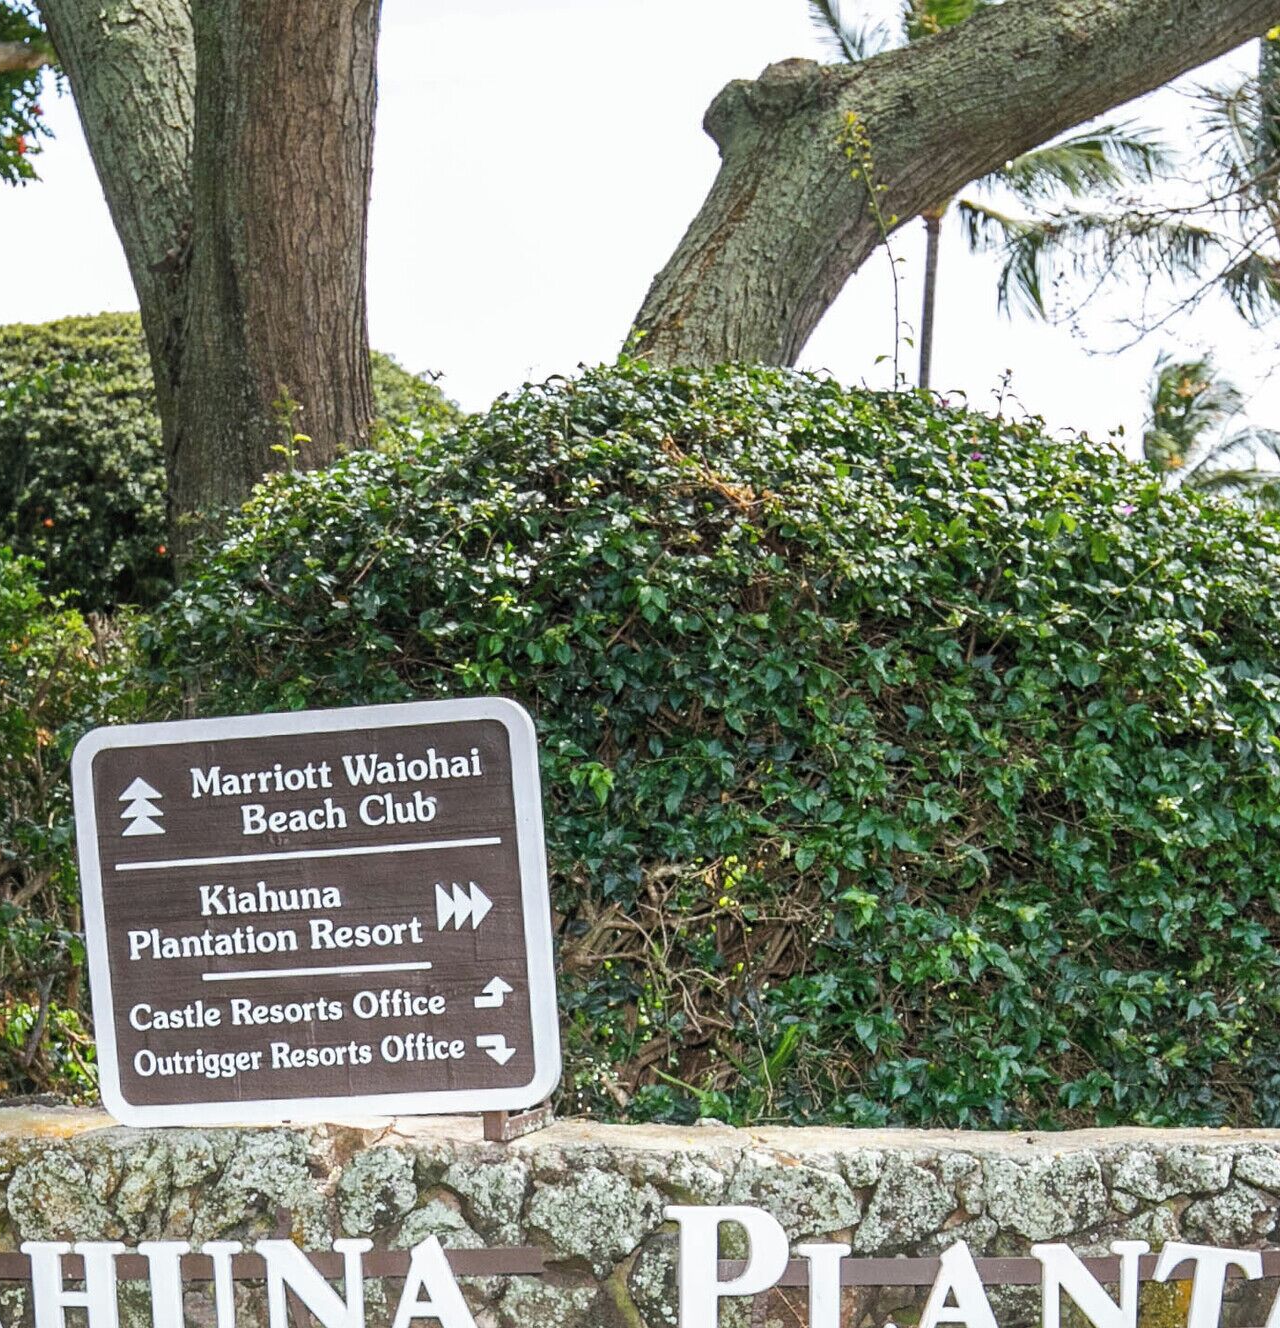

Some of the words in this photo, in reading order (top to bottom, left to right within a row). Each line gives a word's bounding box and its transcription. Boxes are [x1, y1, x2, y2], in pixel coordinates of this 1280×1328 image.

[190, 762, 332, 798] Marriott
[342, 748, 482, 785] Waiohai
[241, 798, 347, 834] Beach
[360, 791, 437, 825] Club
[200, 881, 341, 915] Kiahuna
[128, 926, 298, 960] Plantation
[309, 917, 423, 949] Resort
[130, 1001, 221, 1030] Castle
[231, 998, 342, 1025] Resorts
[353, 989, 445, 1018] Office
[134, 1049, 262, 1078] Outrigger
[271, 1041, 372, 1069] Resorts
[381, 1033, 465, 1062] Office
